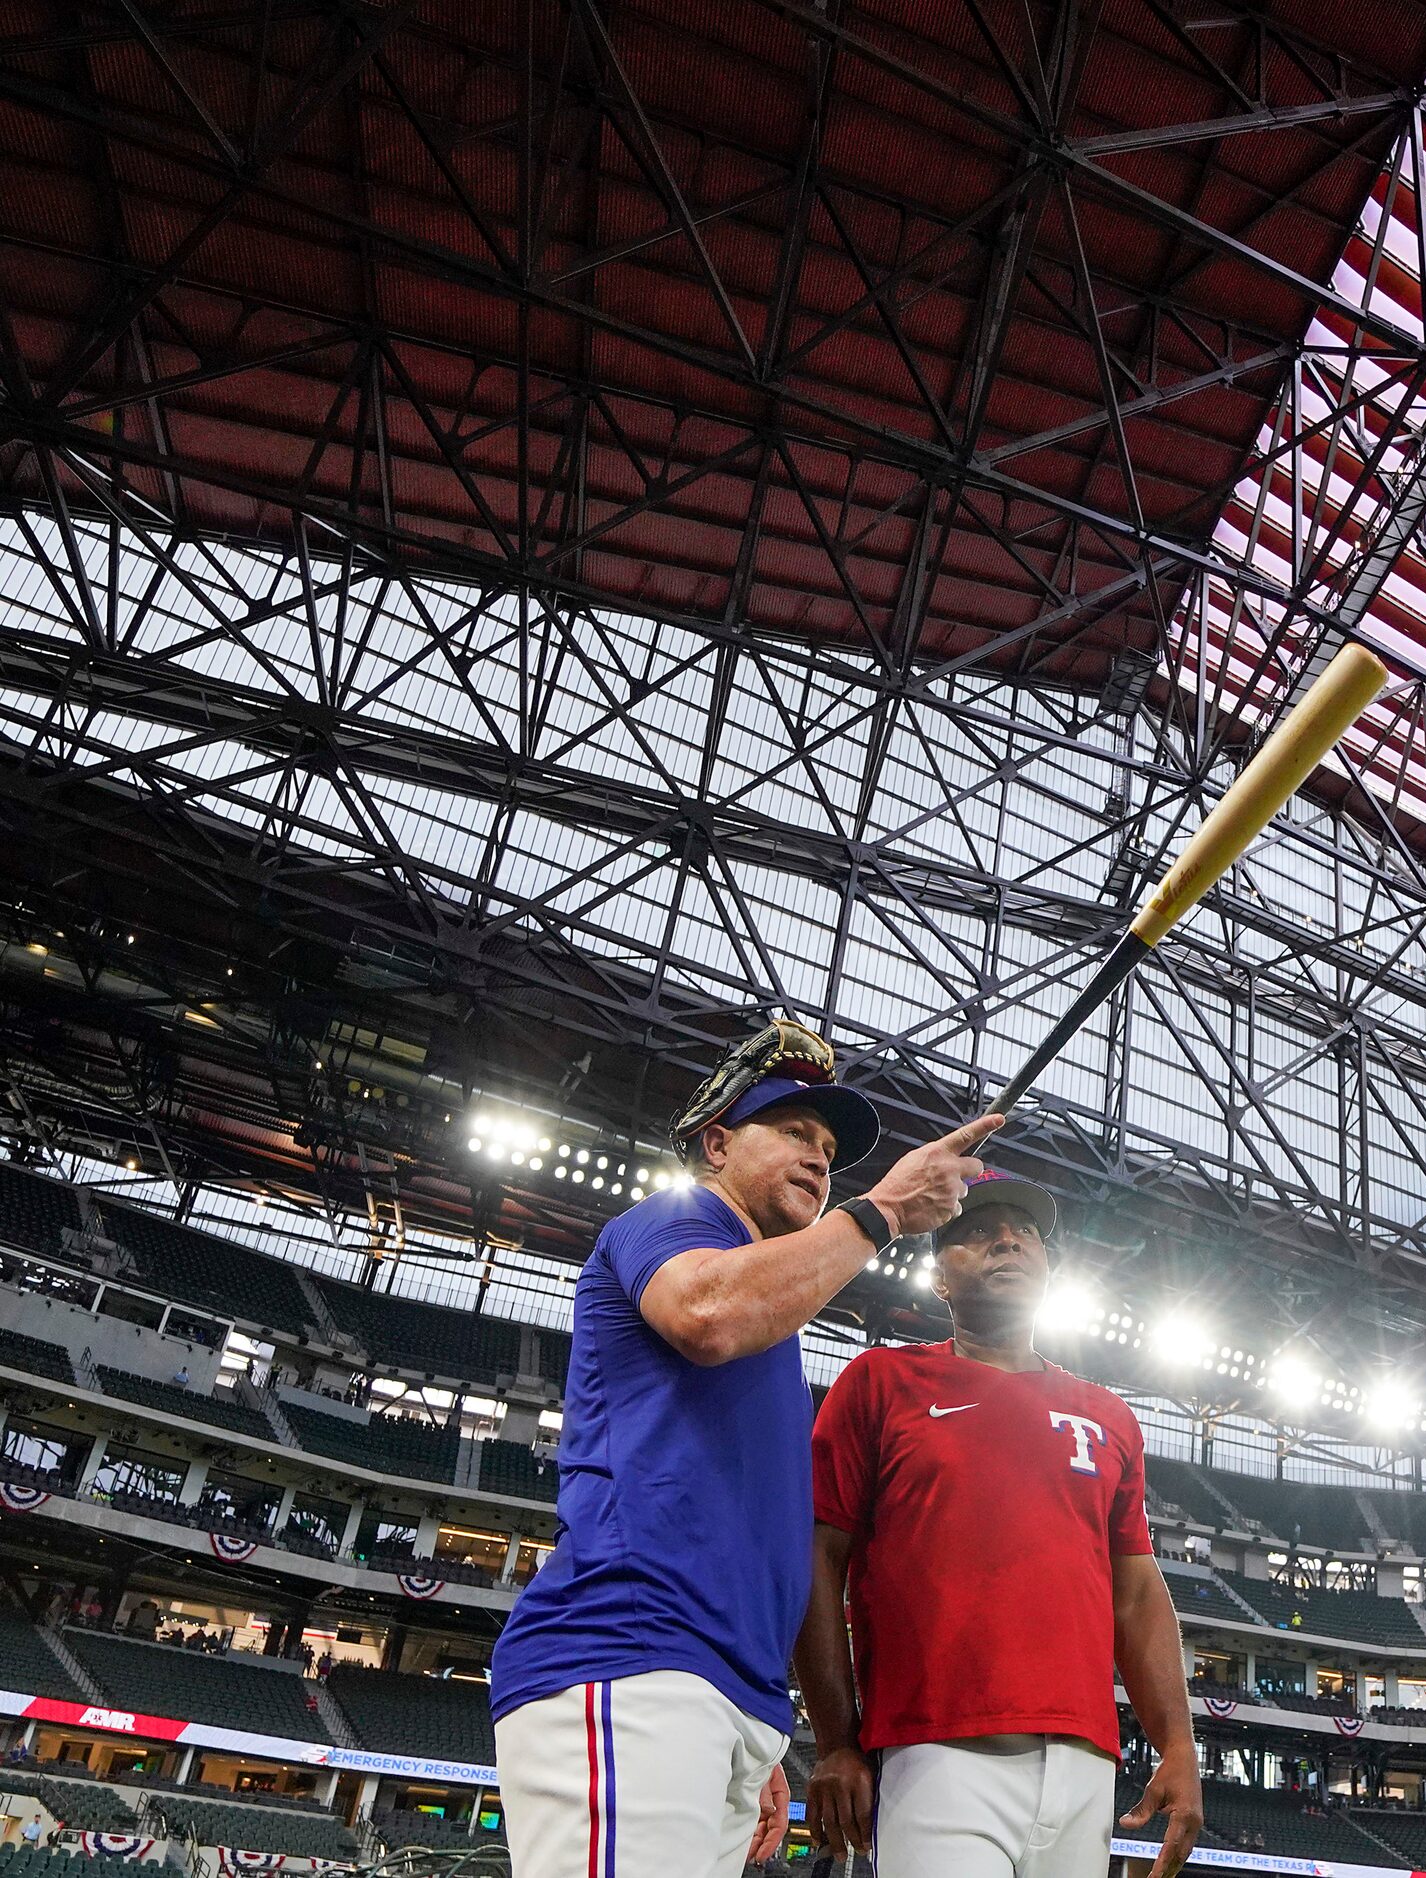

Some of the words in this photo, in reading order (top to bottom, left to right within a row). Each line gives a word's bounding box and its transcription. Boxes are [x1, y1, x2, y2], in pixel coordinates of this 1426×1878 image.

[1048, 1410, 1107, 1477] T
[79, 1707, 136, 1732] AMR
[333, 1751, 421, 1773] EMERGENCY
[424, 1763, 497, 1781] RESPONSE
[1111, 1841, 1148, 1853] GENCY
[1206, 1851, 1233, 1863] TEAM
[1235, 1854, 1250, 1865] OF
[1251, 1856, 1270, 1867] THE
[1271, 1858, 1304, 1870] TEXAS
